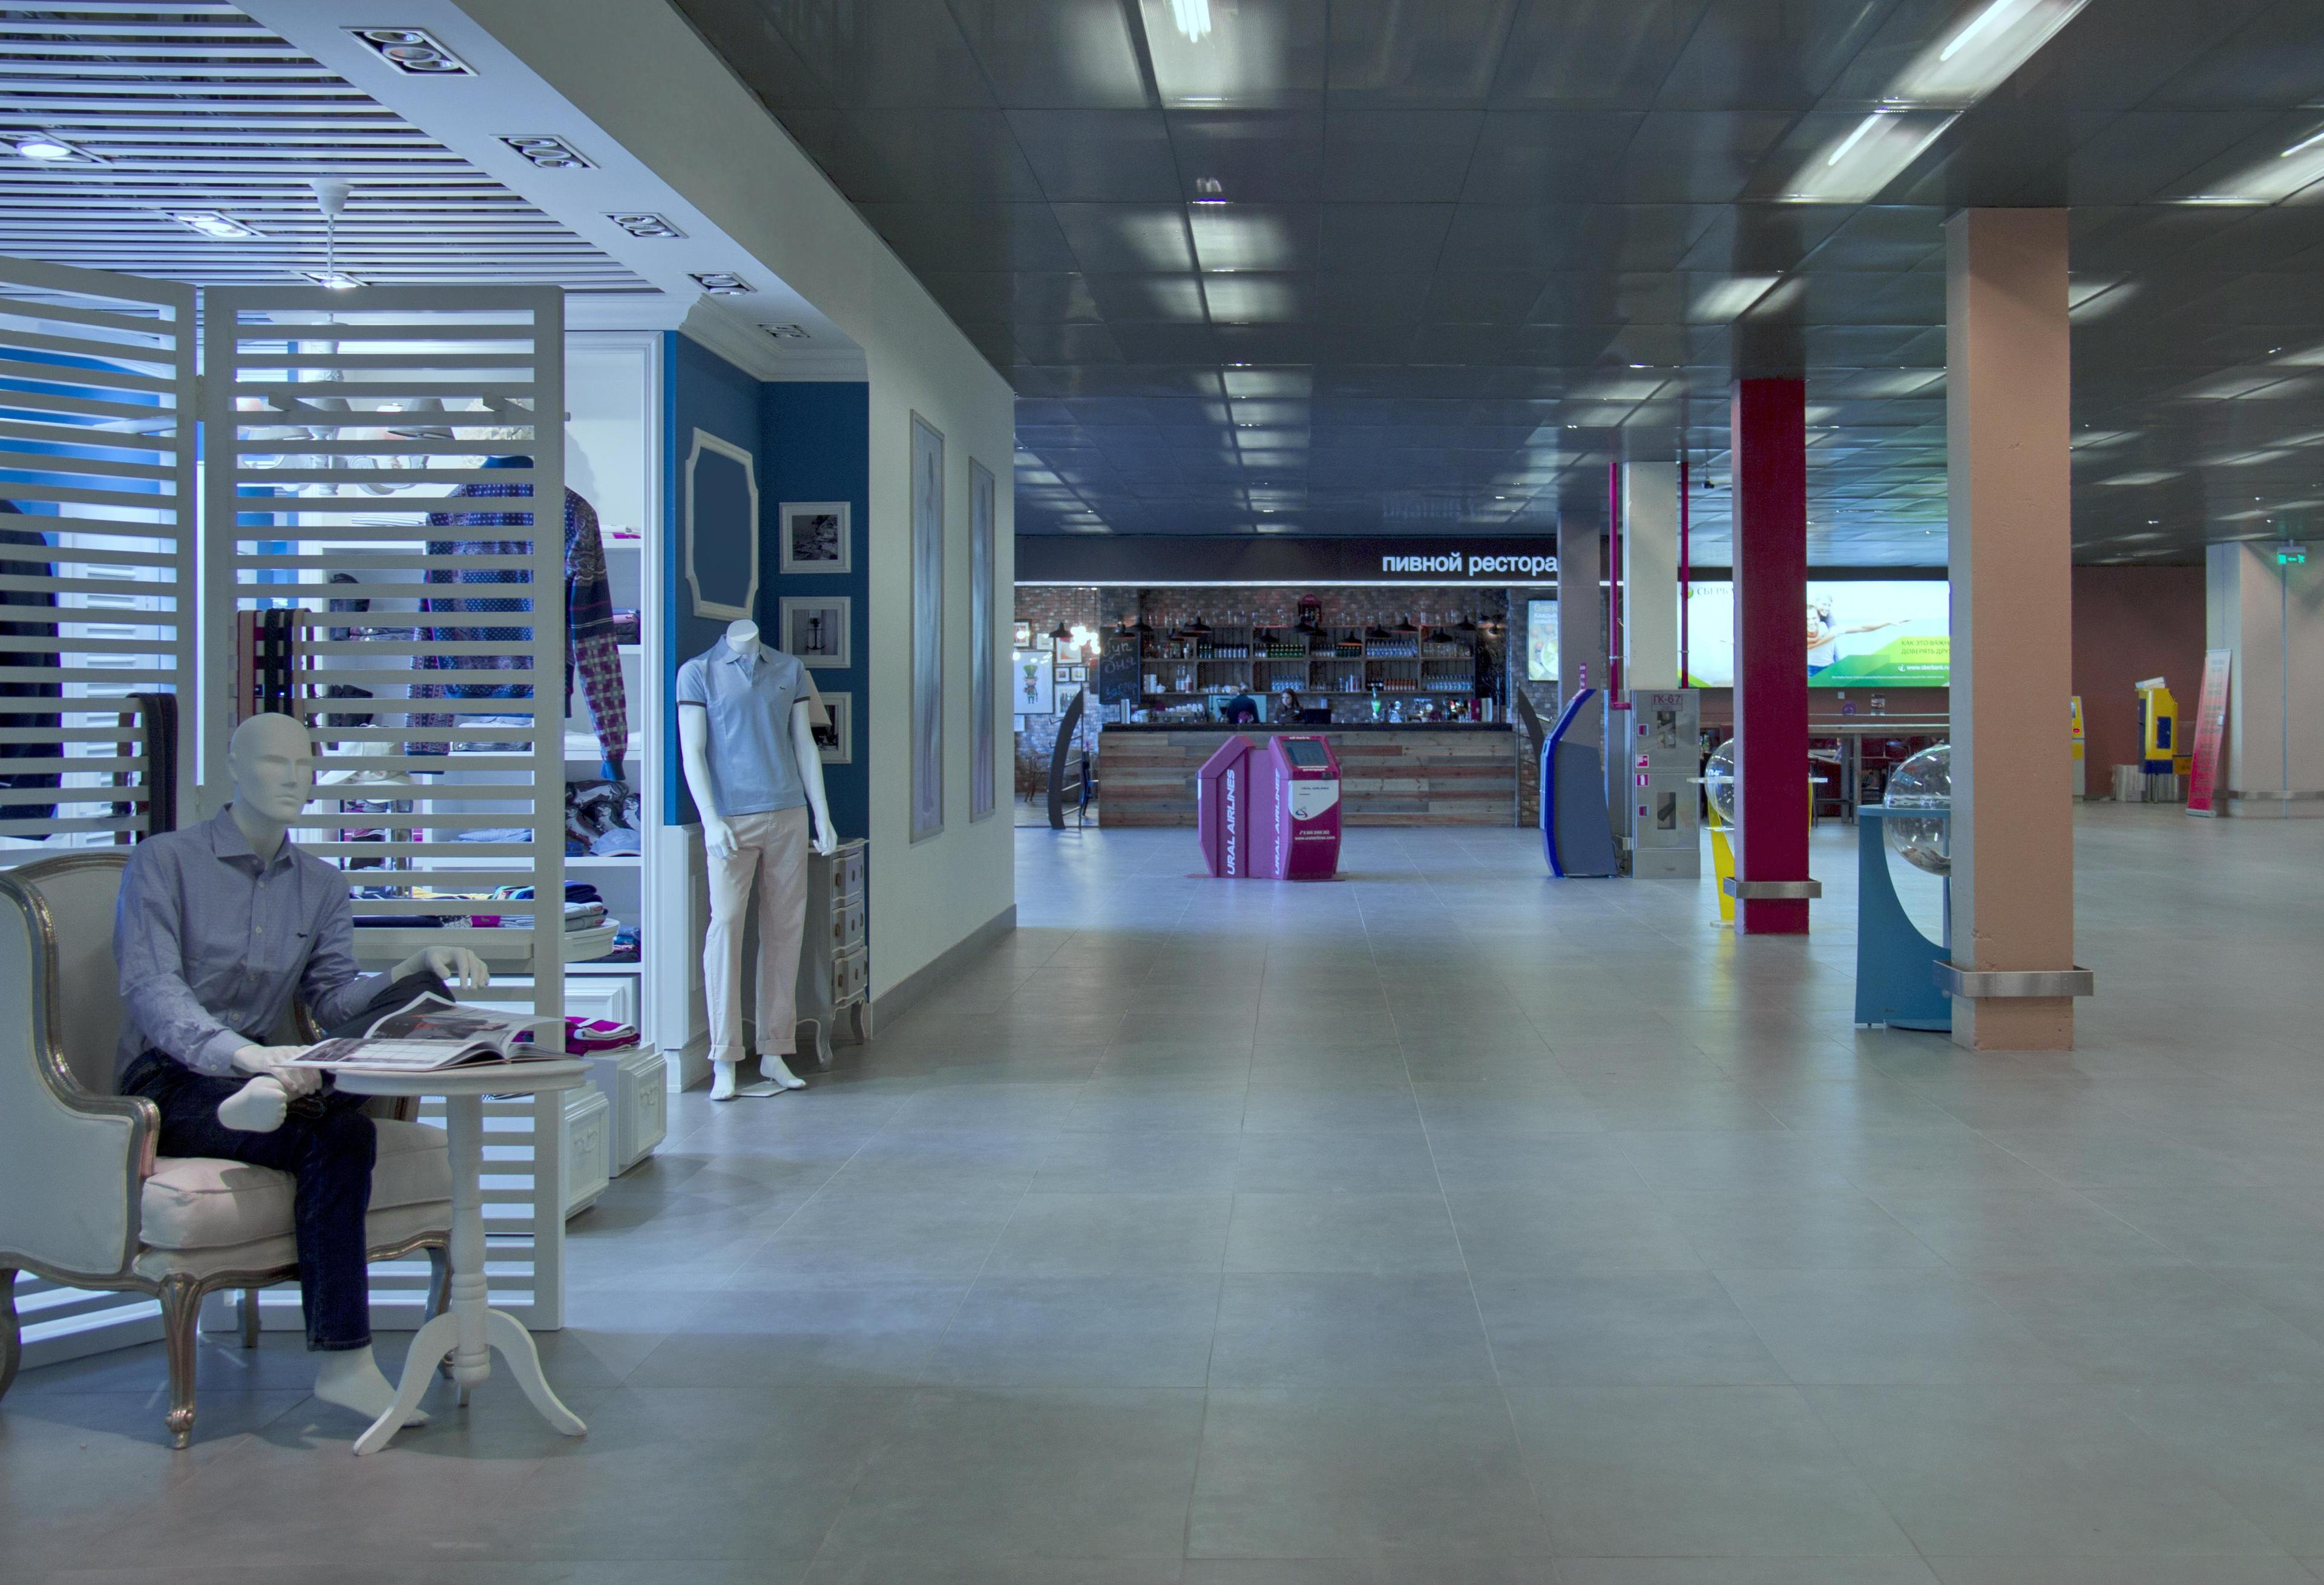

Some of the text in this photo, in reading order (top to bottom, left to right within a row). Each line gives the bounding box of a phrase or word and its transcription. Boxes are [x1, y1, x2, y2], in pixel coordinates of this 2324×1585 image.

[1382, 551, 1558, 576] пивной рестора
[1227, 769, 1235, 875] URAL AIRLINES
